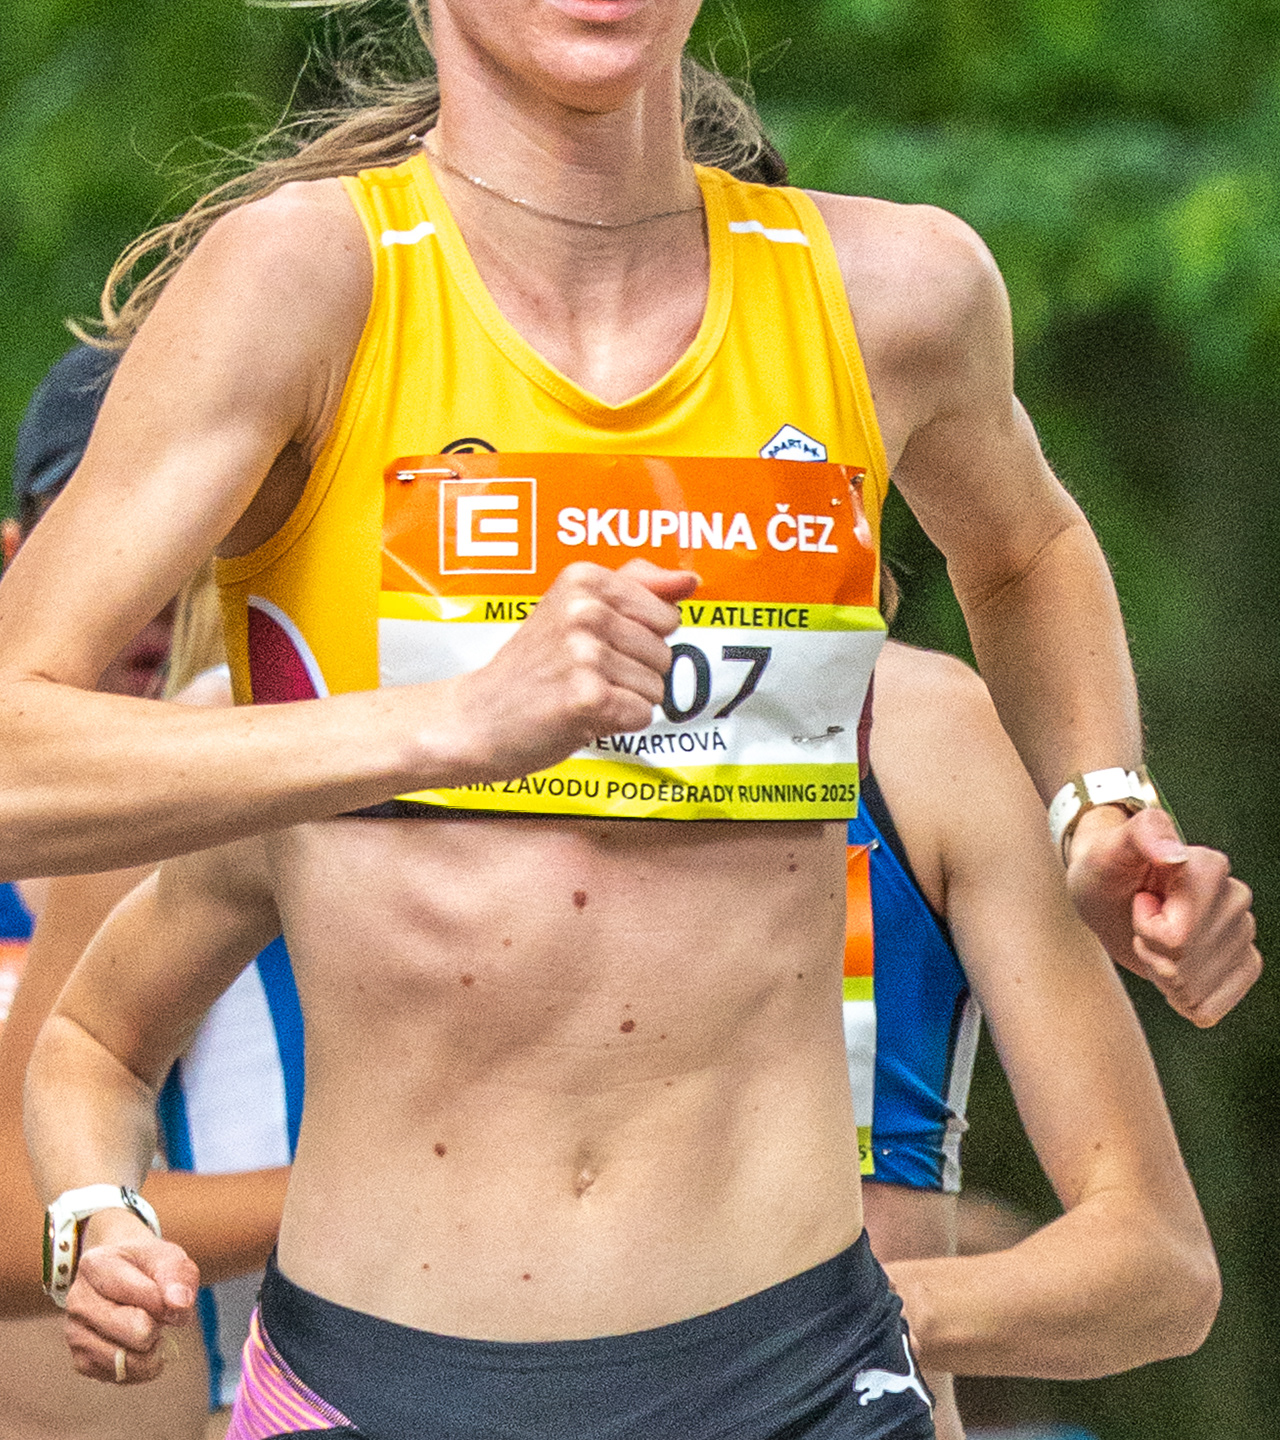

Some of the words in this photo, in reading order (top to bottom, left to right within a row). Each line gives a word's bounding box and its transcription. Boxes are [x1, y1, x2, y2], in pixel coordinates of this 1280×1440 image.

[557, 507, 758, 550] SKUPINA
[766, 503, 839, 554] ČEZ
[688, 606, 705, 624] V
[710, 606, 810, 628] ATLETICE
[661, 643, 773, 724] 07
[586, 727, 728, 755] EWARTOVÁ
[606, 779, 734, 803] PODĚBRADY
[738, 783, 817, 803] RUNNING
[821, 783, 856, 803] 2025
